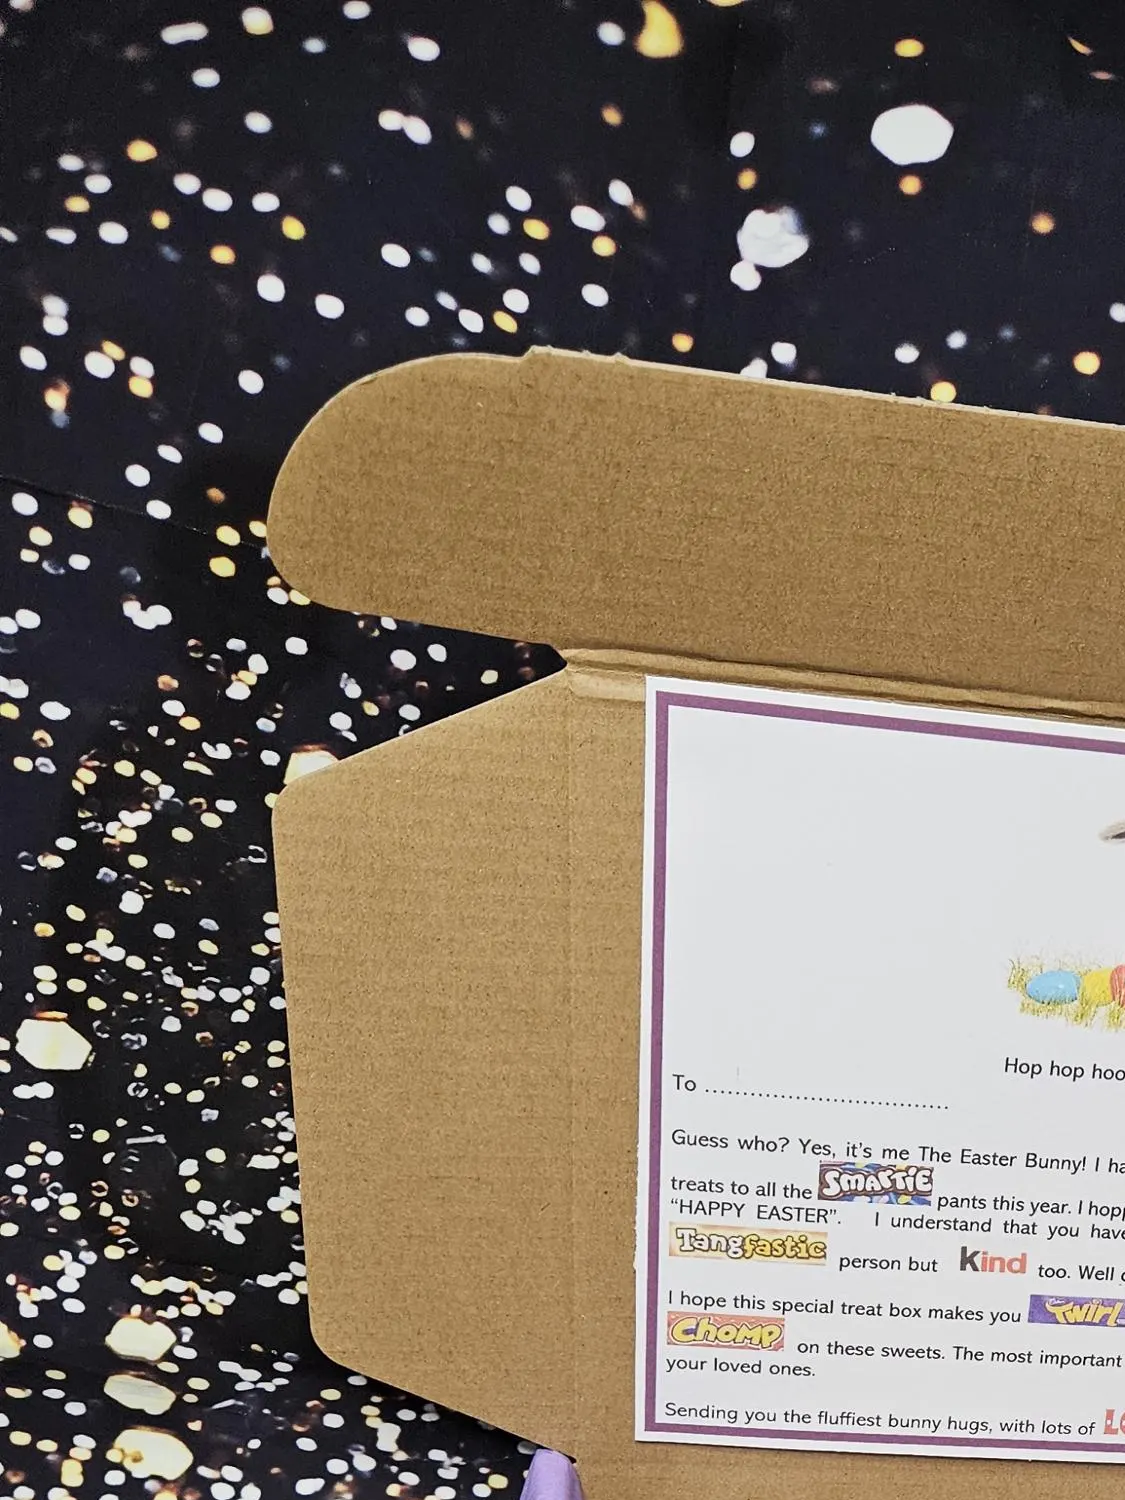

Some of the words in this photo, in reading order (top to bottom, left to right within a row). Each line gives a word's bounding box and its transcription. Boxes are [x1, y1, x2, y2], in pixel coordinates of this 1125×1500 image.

[672, 1074, 696, 1091] To
[1005, 1057, 1042, 1079] Hop
[1050, 1060, 1084, 1082] hop
[672, 1129, 728, 1148] Guess
[737, 1135, 790, 1152] who?
[799, 1138, 835, 1159] Yes,
[882, 1148, 909, 1161] me
[918, 1146, 951, 1163] The
[961, 1149, 1017, 1167] Easter
[1025, 1153, 1086, 1175] Bunny!
[1095, 1157, 1099, 1172] I
[671, 1177, 724, 1193] treats
[731, 1181, 749, 1195] to
[756, 1182, 776, 1197] all
[783, 1183, 812, 1199] the
[937, 1196, 986, 1211] pants
[993, 1195, 1024, 1211] this
[1029, 1202, 1071, 1216] year.
[1078, 1200, 1083, 1215] I
[875, 1212, 879, 1226] I
[891, 1214, 992, 1232] understand
[1003, 1219, 1038, 1235] that
[1047, 1225, 1079, 1240] you
[839, 1257, 900, 1271] person
[909, 1256, 938, 1272] but
[960, 1246, 1027, 1274] Kind
[1038, 1265, 1070, 1278] too.
[1079, 1265, 1114, 1281] Well
[669, 1290, 672, 1304] I
[681, 1290, 726, 1310] hope
[733, 1294, 765, 1310] this
[772, 1299, 834, 1315] special
[841, 1302, 883, 1316] treat
[889, 1303, 921, 1318] box
[928, 1306, 983, 1321] makes
[989, 1312, 1021, 1325] you
[666, 1359, 707, 1372] your
[714, 1357, 761, 1374] loved
[769, 1365, 815, 1376] ones.
[797, 1343, 819, 1353] on
[827, 1341, 875, 1356] these
[881, 1346, 944, 1359] sweets.
[953, 1346, 984, 1361] The
[991, 1351, 1032, 1363] most
[1040, 1350, 1122, 1368] important
[665, 1402, 738, 1424] Sending
[745, 1411, 776, 1424] you
[784, 1409, 811, 1424] the
[818, 1411, 882, 1427] fluffiest
[889, 1414, 941, 1433] bunny
[948, 1416, 992, 1435] hugs,
[1000, 1419, 1035, 1433] with
[1042, 1420, 1071, 1434] lots
[1078, 1422, 1096, 1435] of
